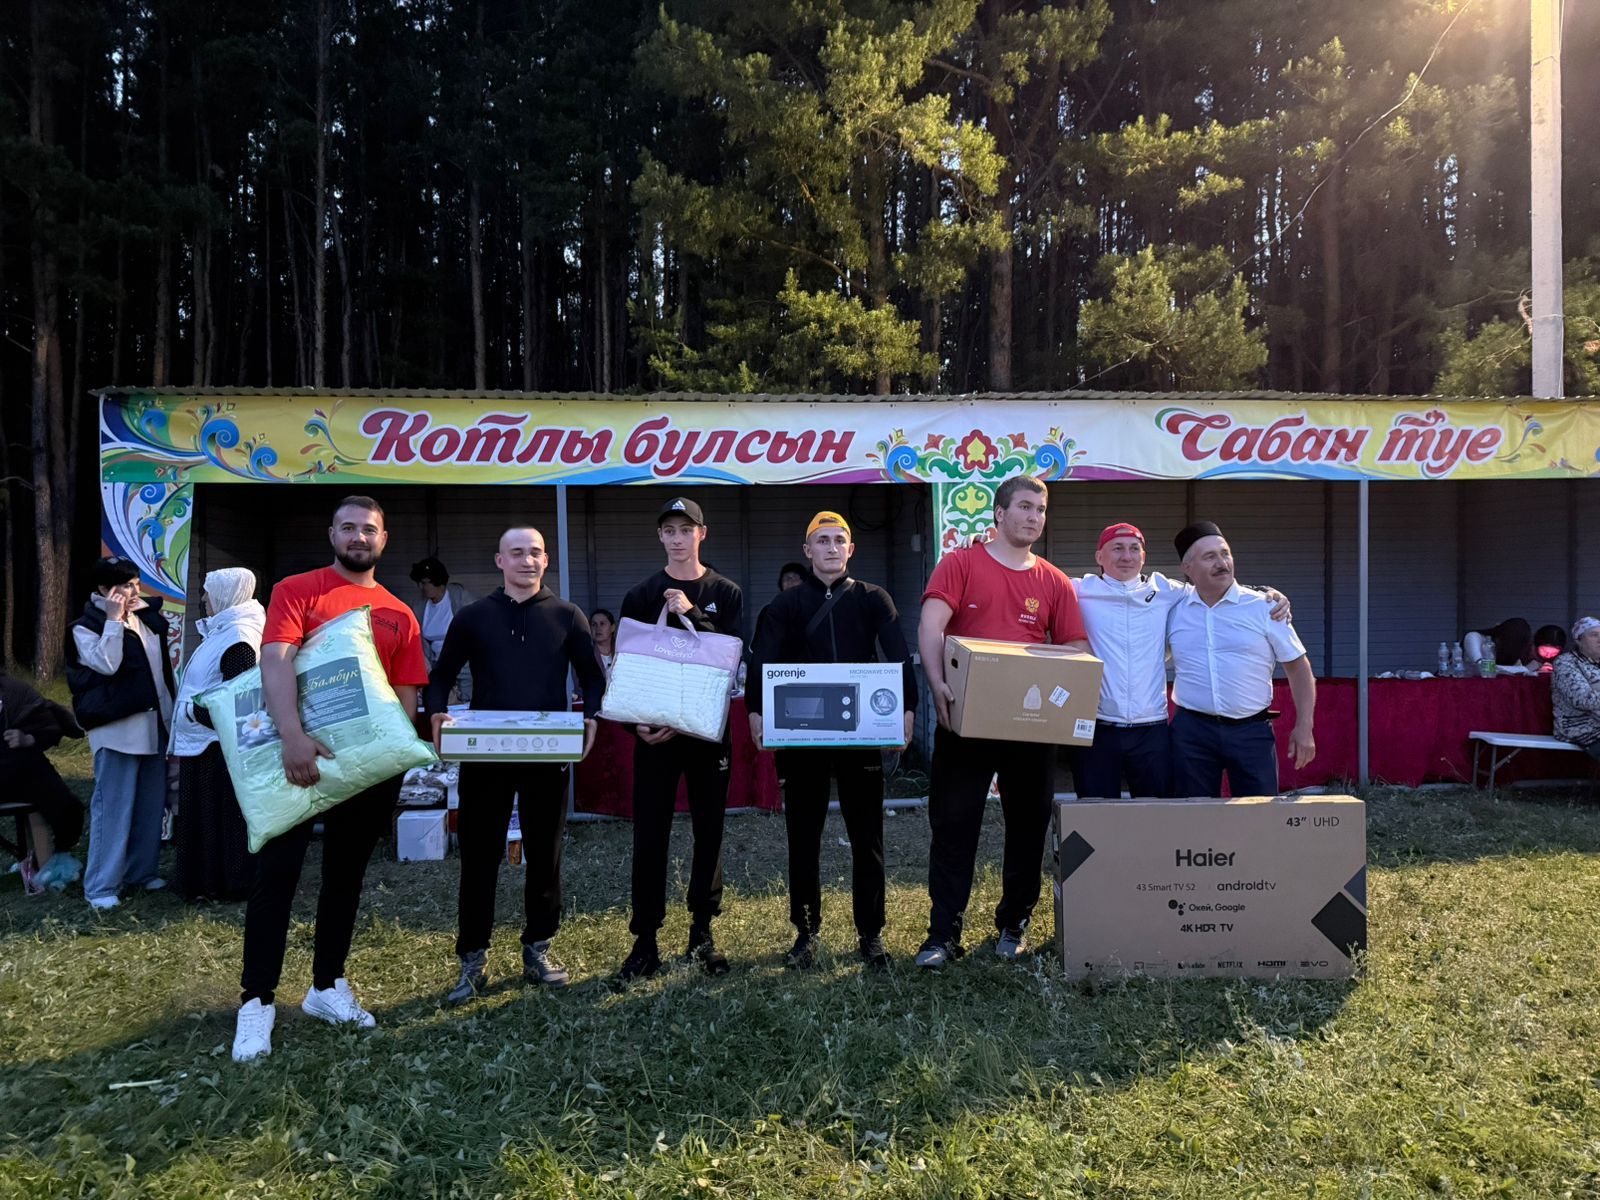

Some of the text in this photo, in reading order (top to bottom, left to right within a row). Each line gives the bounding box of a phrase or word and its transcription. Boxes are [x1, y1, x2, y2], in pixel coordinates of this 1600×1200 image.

[361, 410, 856, 477] Котлы булсын
[1158, 408, 1502, 477] Сабан туе
[304, 668, 360, 692] Бамбук
[766, 667, 807, 680] gorenje
[1313, 816, 1340, 827] UHD
[1175, 848, 1236, 867] Haier
[1136, 883, 1196, 892] 43 Smart TV S2
[1214, 903, 1246, 913] Google
[1180, 923, 1234, 933] 4K HDR TV
